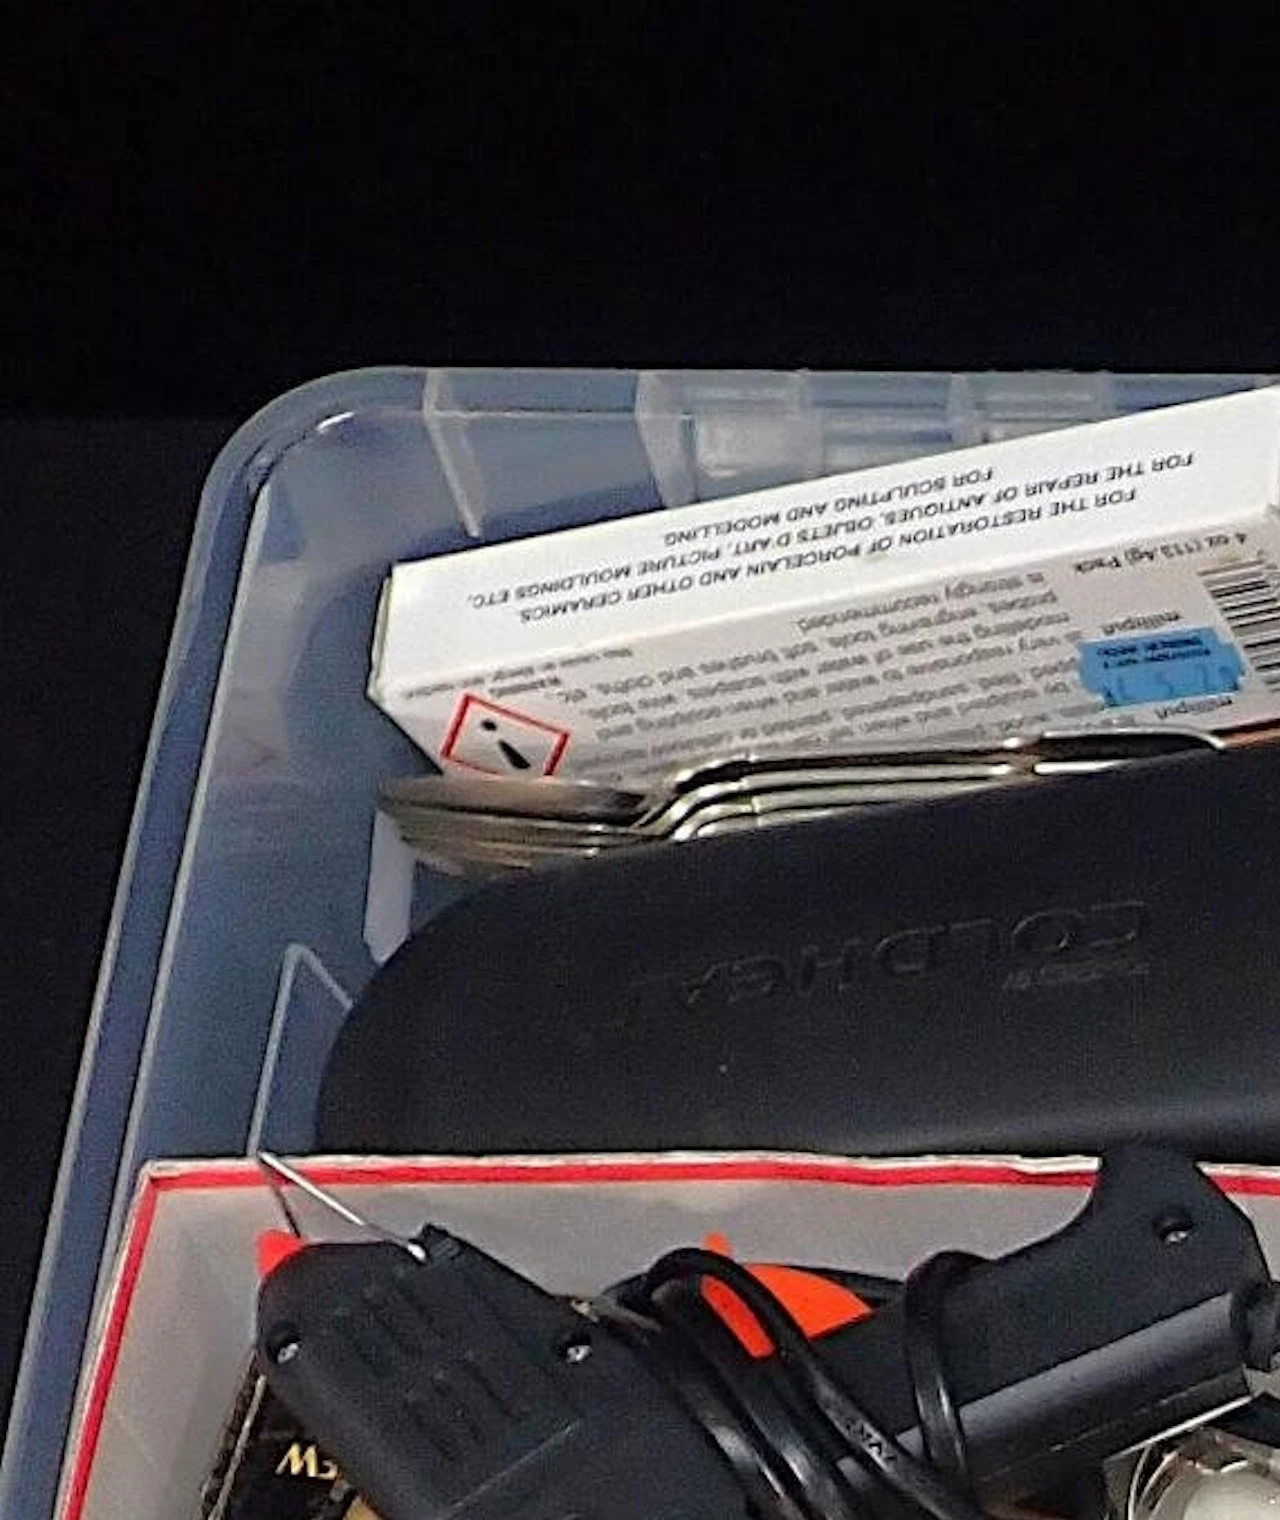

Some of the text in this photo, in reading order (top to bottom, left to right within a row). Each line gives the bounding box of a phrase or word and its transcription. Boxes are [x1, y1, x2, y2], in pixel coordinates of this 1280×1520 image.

[1106, 462, 1144, 481] THE
[1151, 452, 1195, 473] FOR
[992, 487, 1018, 503] OF
[1025, 471, 1098, 498] REPAIR
[521, 489, 1136, 624] FOR THE RESTORATION OF PORCELAIN AND OTHER CERAMICS
[638, 548, 720, 575] PICTURE
